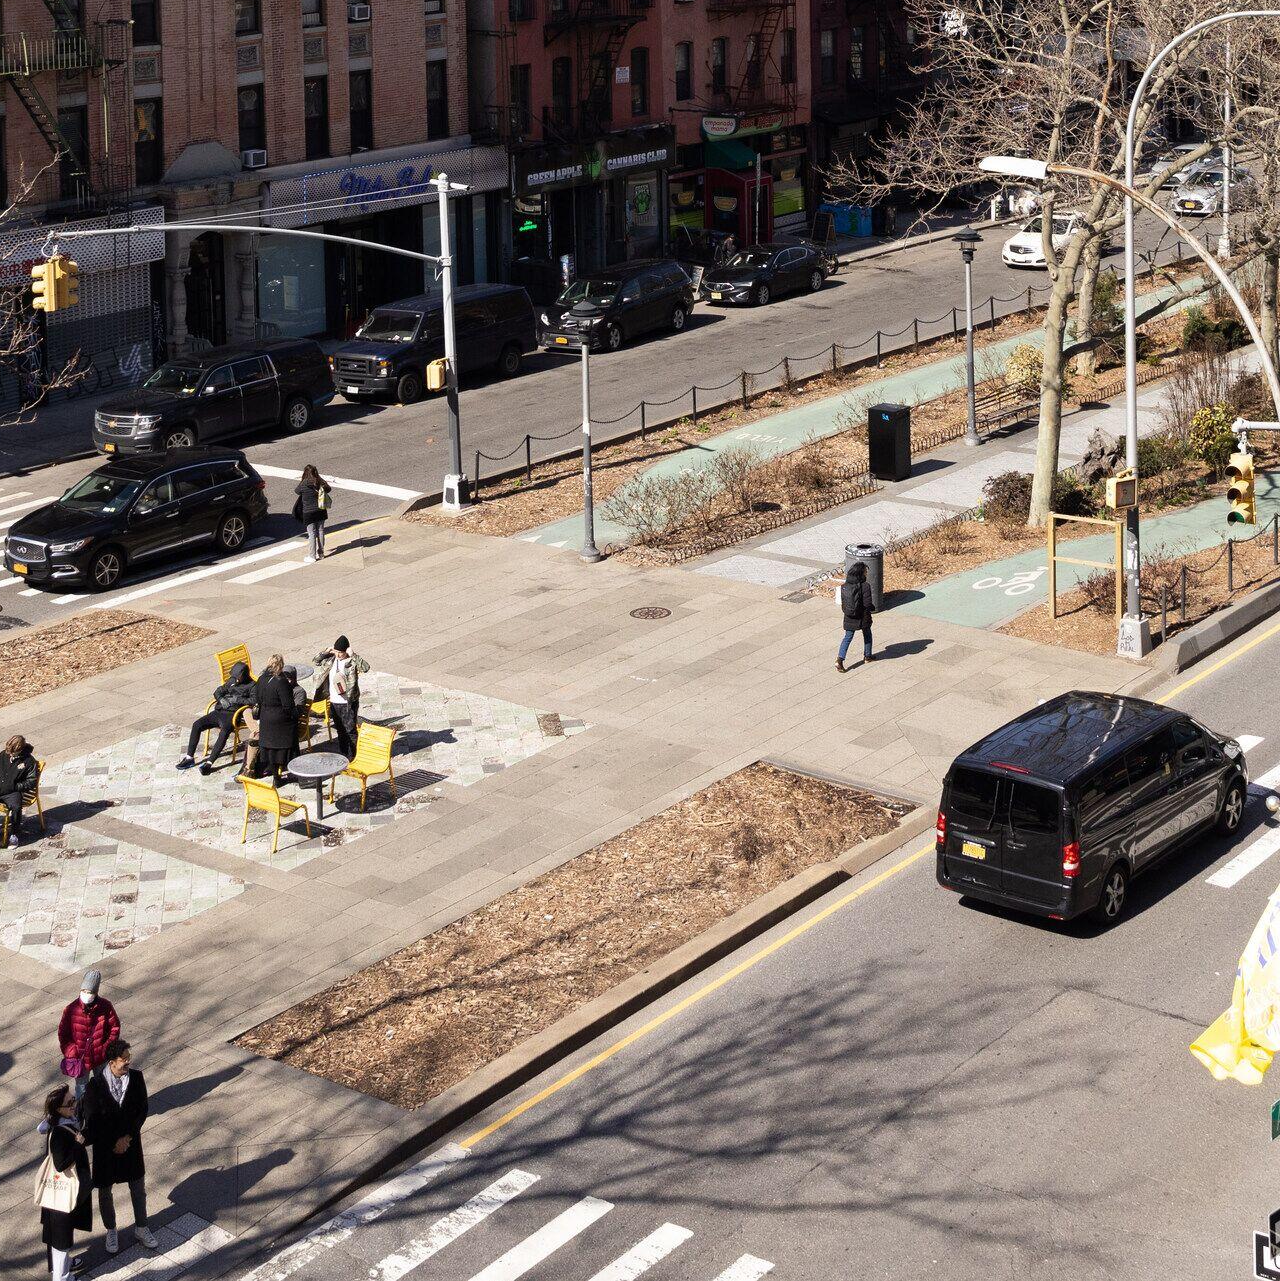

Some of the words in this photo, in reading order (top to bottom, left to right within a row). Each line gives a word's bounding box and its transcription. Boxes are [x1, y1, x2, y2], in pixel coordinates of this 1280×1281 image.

[527, 168, 556, 186] GREEN
[556, 164, 583, 180] APPLE
[607, 152, 646, 170] CANNABIS
[646, 148, 667, 164] CLUB
